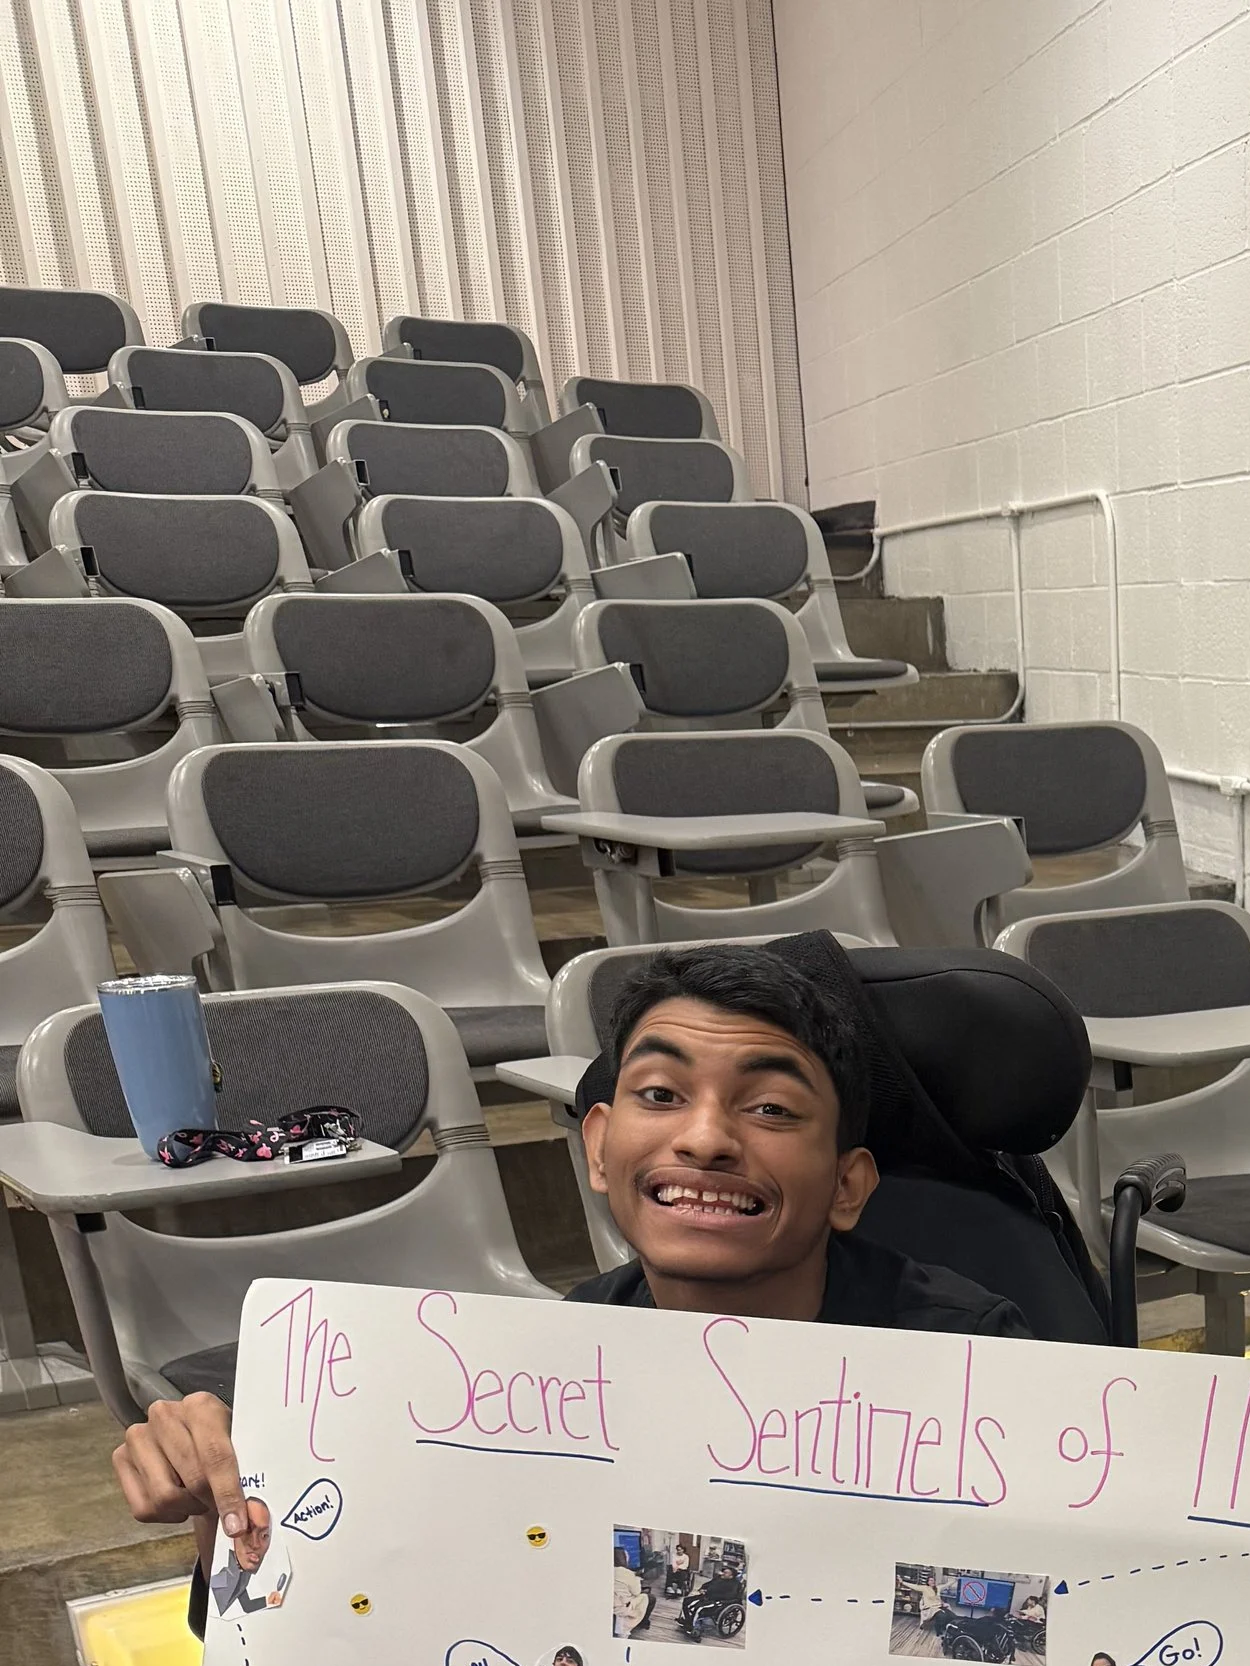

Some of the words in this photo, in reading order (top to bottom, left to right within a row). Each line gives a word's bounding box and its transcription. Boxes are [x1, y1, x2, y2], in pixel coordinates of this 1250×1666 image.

[261, 1287, 356, 1461] The
[408, 1291, 619, 1451] Secret
[704, 1318, 1006, 1506] Sentinels
[1058, 1377, 1137, 1508] of
[240, 1472, 265, 1488] art!
[294, 1495, 334, 1524] Action!
